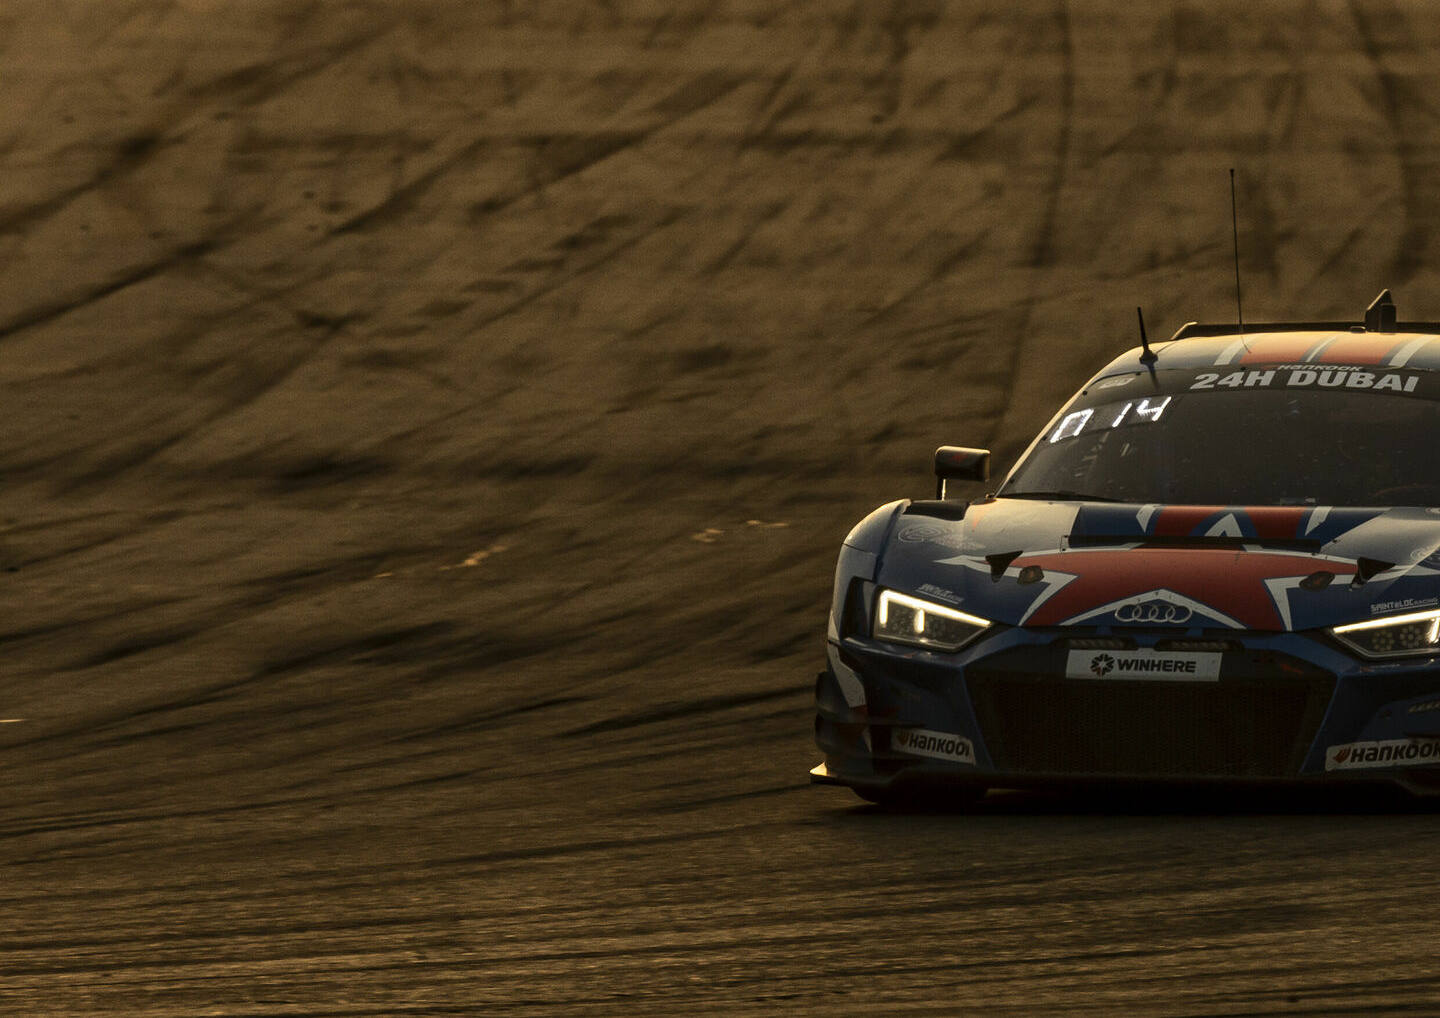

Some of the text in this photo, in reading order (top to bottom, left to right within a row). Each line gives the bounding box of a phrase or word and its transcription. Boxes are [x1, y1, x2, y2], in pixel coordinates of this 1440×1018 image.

[1189, 370, 1420, 393] 24H DUBAI
[1117, 658, 1197, 673] WINHERE
